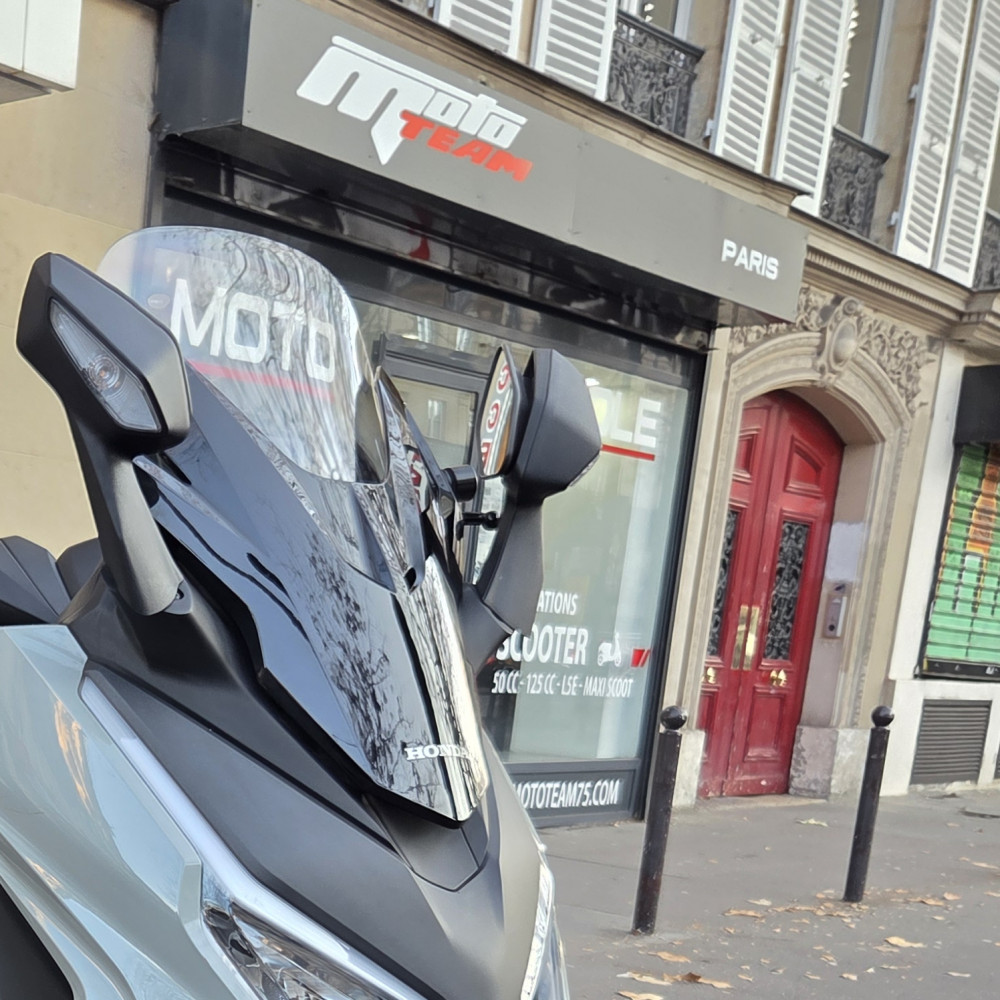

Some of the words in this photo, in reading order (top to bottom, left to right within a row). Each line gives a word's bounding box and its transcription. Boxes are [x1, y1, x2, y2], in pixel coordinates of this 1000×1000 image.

[400, 109, 533, 182] TEAM
[721, 238, 779, 280] PARIS
[170, 278, 336, 383] MOTO
[536, 589, 579, 616] ATIONS
[496, 623, 589, 666] SCOOTER
[491, 669, 508, 694] 50
[506, 669, 520, 694] CC
[526, 672, 545, 695] 125
[543, 673, 559, 695] CC
[583, 675, 607, 698] MAXI
[605, 677, 634, 698] SCOOT
